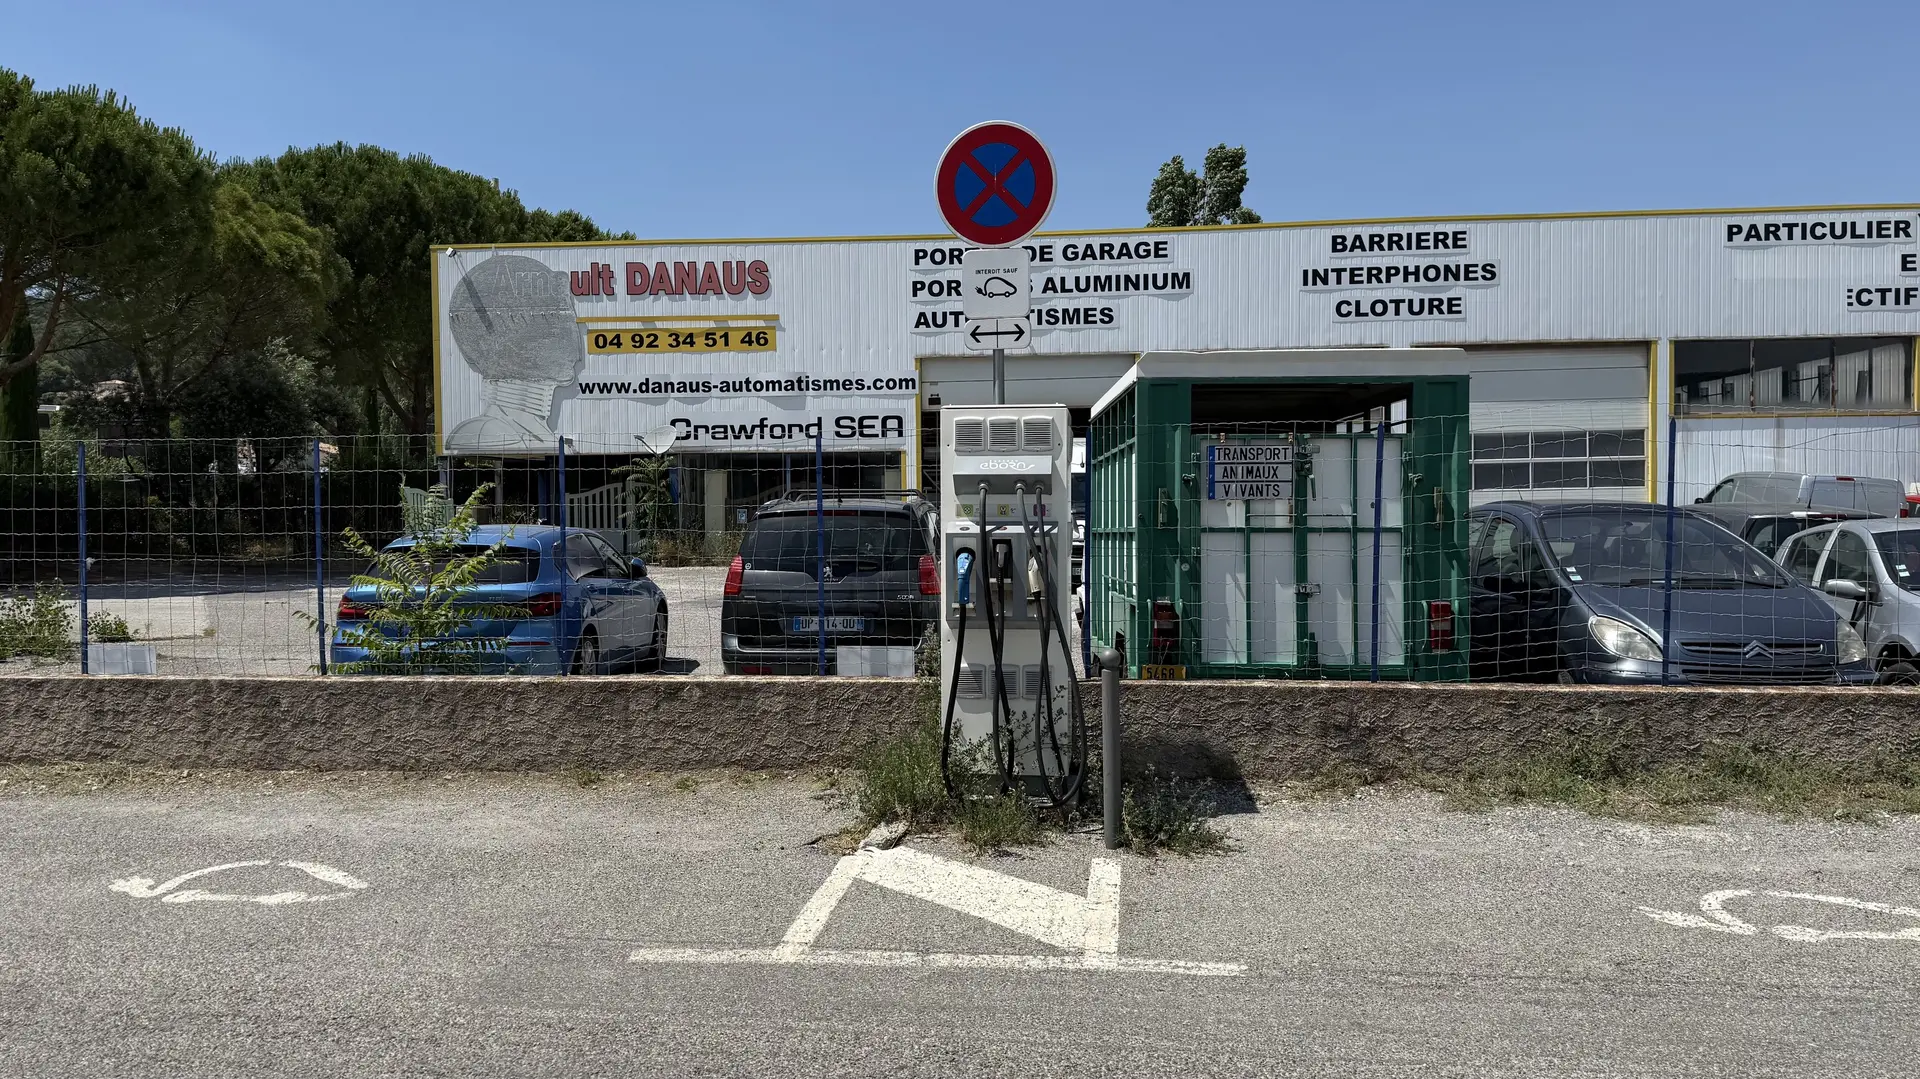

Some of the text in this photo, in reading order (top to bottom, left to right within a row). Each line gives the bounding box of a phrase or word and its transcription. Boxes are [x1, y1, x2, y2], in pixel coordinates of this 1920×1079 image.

[1727, 219, 1912, 242] PARTICULIER
[1062, 241, 1169, 261] GARAGE
[1331, 230, 1468, 253] BARRIERE
[625, 259, 770, 296] DANAUS
[1042, 272, 1191, 294] ALUMINIUM
[1302, 263, 1497, 286] INTERPHONES
[914, 306, 1114, 329] AUTISMES
[1335, 297, 1463, 317] CLOTURE
[594, 331, 769, 349] 04 92 34 51 46
[578, 375, 917, 395] www.danaus-automatismes.com
[670, 415, 904, 441] Crawford SEA
[1216, 447, 1289, 461] TRANSPORT
[1222, 465, 1279, 480] ANIMAUX
[1223, 483, 1280, 497] VIVANTS
